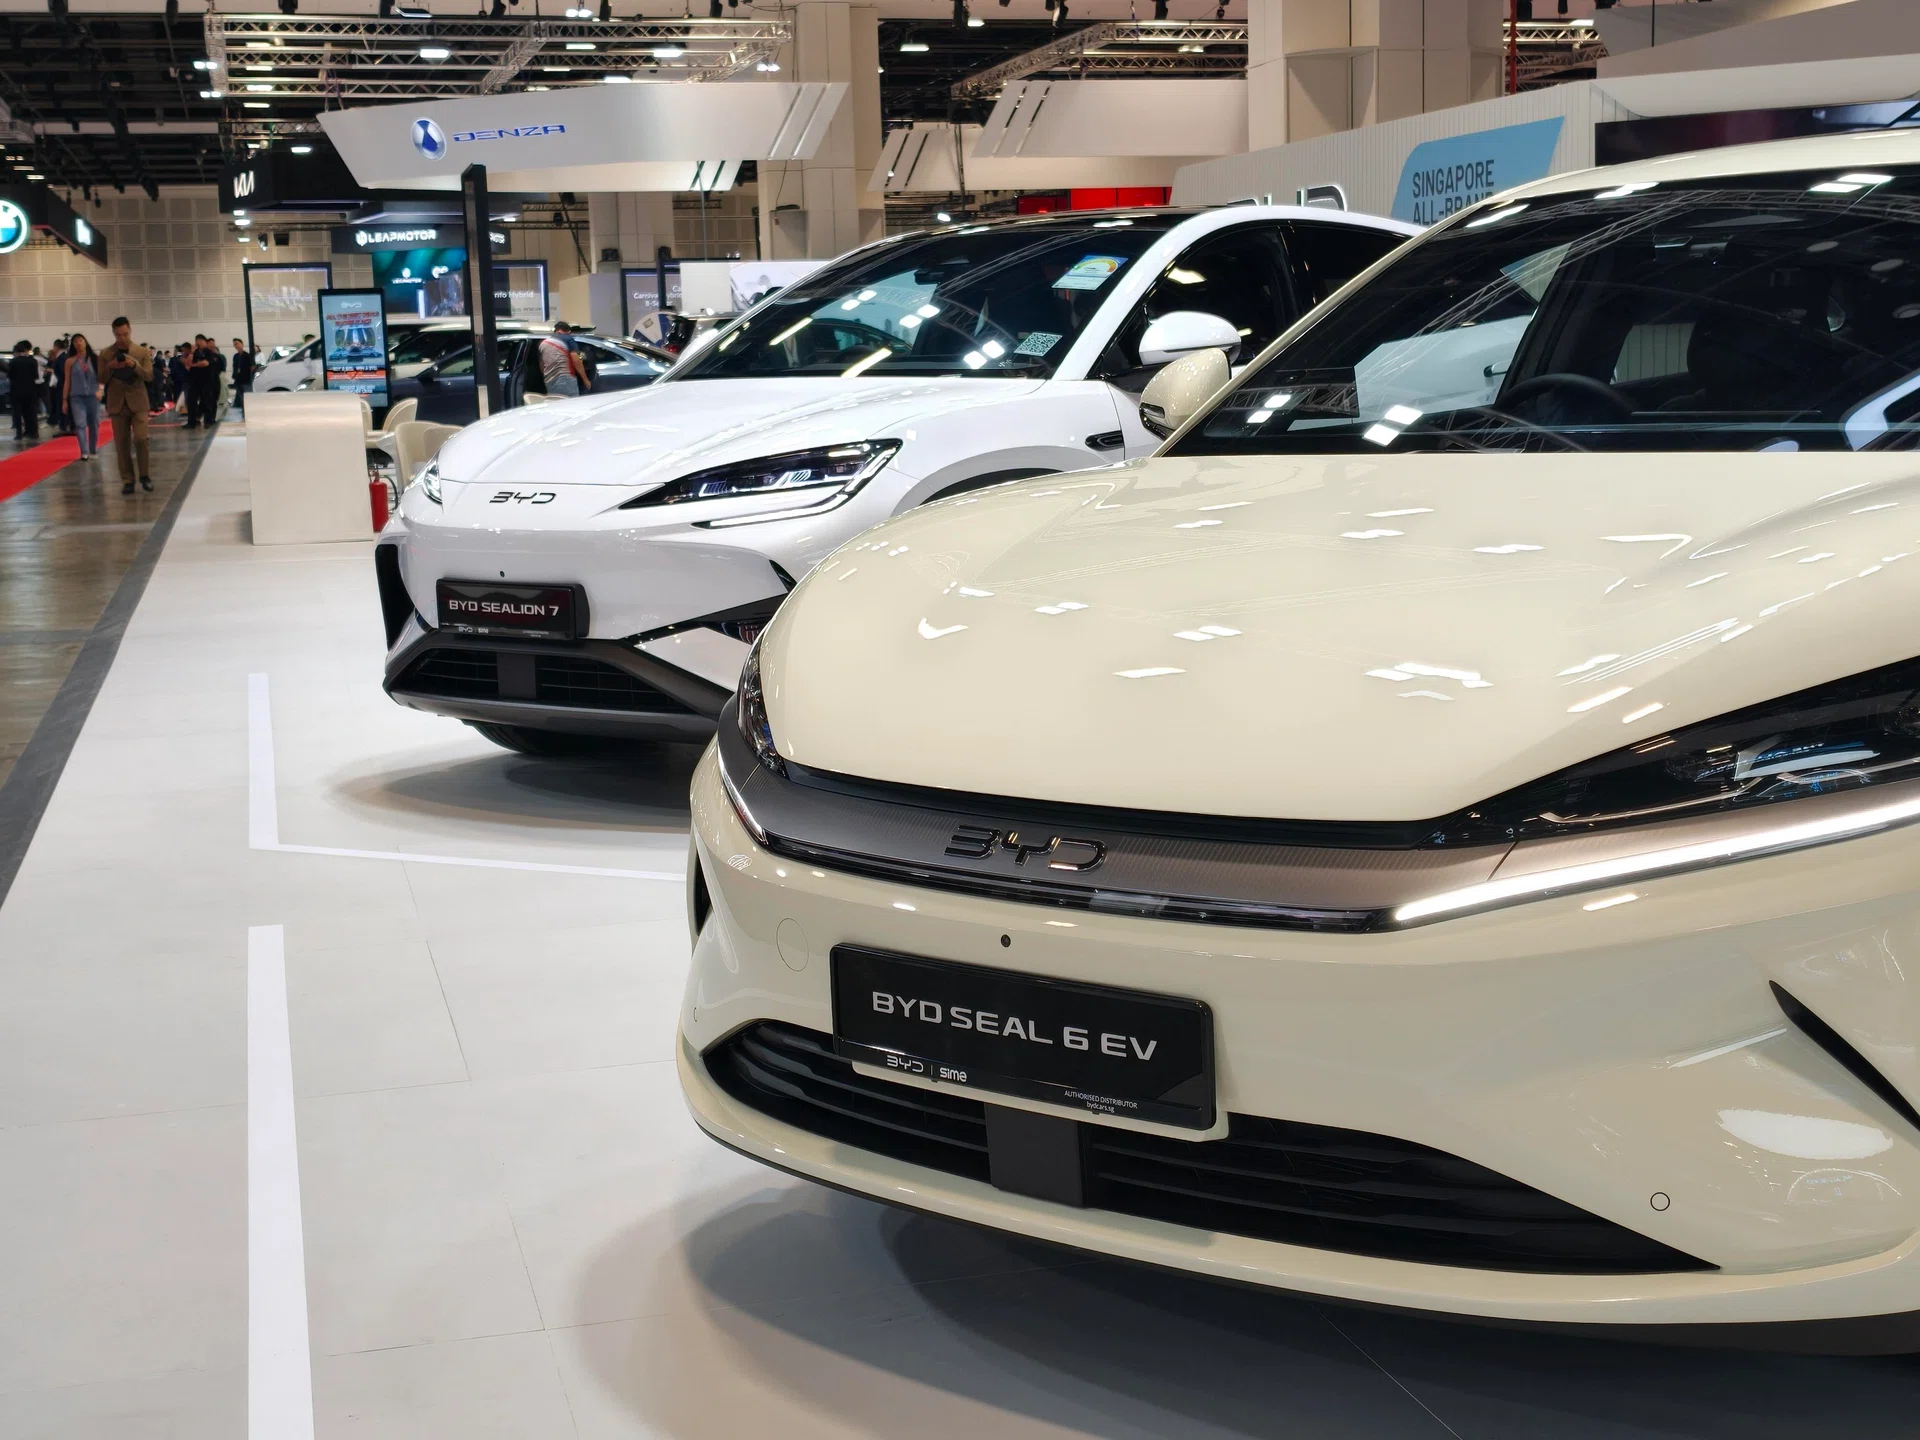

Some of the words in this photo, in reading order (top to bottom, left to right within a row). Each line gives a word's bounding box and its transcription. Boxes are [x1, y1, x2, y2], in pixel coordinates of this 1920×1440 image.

[453, 124, 566, 142] DENZA
[1413, 159, 1494, 198] SINGAPORE
[1413, 192, 1494, 225] ALL-BR
[368, 229, 437, 243] LEAPMOTOR
[488, 491, 556, 504] BYD
[449, 600, 478, 612] BYD
[481, 602, 545, 616] SEALION
[549, 605, 559, 616] 7
[943, 824, 1107, 872] BYD
[872, 991, 942, 1024] BYD
[950, 1006, 1053, 1045] SEAL
[1063, 1026, 1089, 1051] 6
[1100, 1032, 1157, 1061] EV
[887, 1055, 923, 1073] BYD
[1064, 1090, 1099, 1102] AUTHORISED
[1100, 1096, 1138, 1109] DISTRIBUTOR
[1086, 1101, 1115, 1113] bydcars.sg
